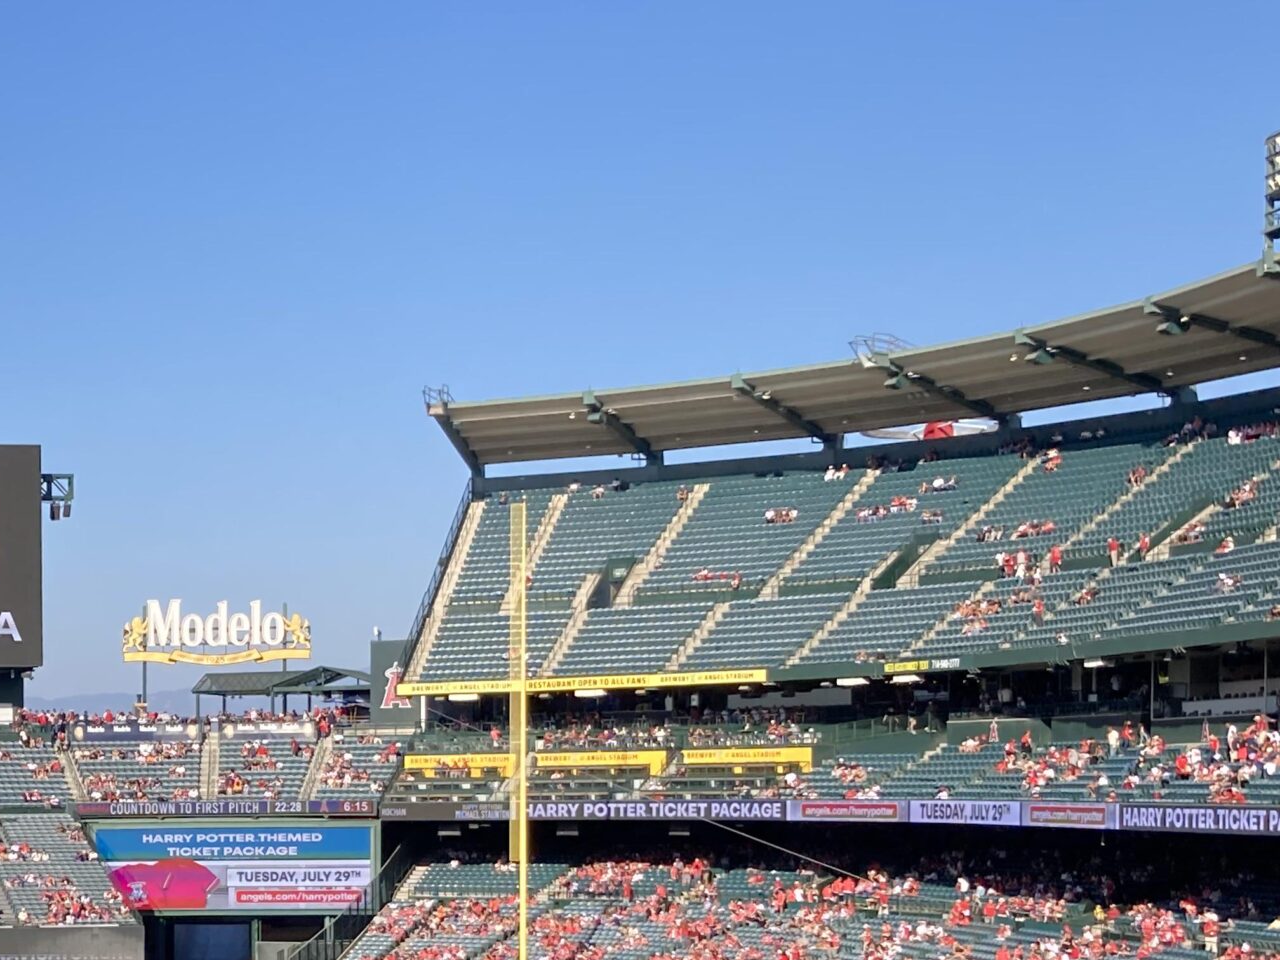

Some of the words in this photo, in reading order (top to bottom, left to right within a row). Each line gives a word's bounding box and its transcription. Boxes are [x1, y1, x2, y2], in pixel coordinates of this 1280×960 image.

[147, 599, 285, 647] Modelo
[528, 678, 576, 689] RESTAURANT
[578, 677, 598, 687] OPEN
[599, 677, 610, 686] TO
[611, 677, 625, 686] ALL
[626, 676, 647, 685] FANS
[109, 802, 175, 815] COUNTDOWN
[179, 802, 192, 814] TO
[195, 802, 224, 814] FIRST
[228, 801, 259, 814] PITCH
[274, 801, 301, 812] 22:28
[343, 801, 368, 812] 6:15
[527, 803, 579, 818] HARRY
[583, 803, 648, 818] POTTER
[649, 803, 707, 817] TICKET
[711, 802, 781, 817] PACKAGE
[920, 803, 968, 822] TUESDAY,
[969, 804, 990, 820] JULY
[1122, 806, 1164, 828] HARRY
[1165, 808, 1214, 829] POTTER
[1218, 809, 1267, 831] TICKET
[142, 833, 193, 844] HARRY
[196, 833, 256, 843] POTTER
[258, 833, 323, 843] THEMED
[167, 847, 220, 856] TICKET
[223, 846, 298, 856] PACKAGE
[236, 871, 298, 884] TUESDAY,
[301, 871, 331, 883] JULY
[240, 892, 358, 903] angels.com/harrypotter
